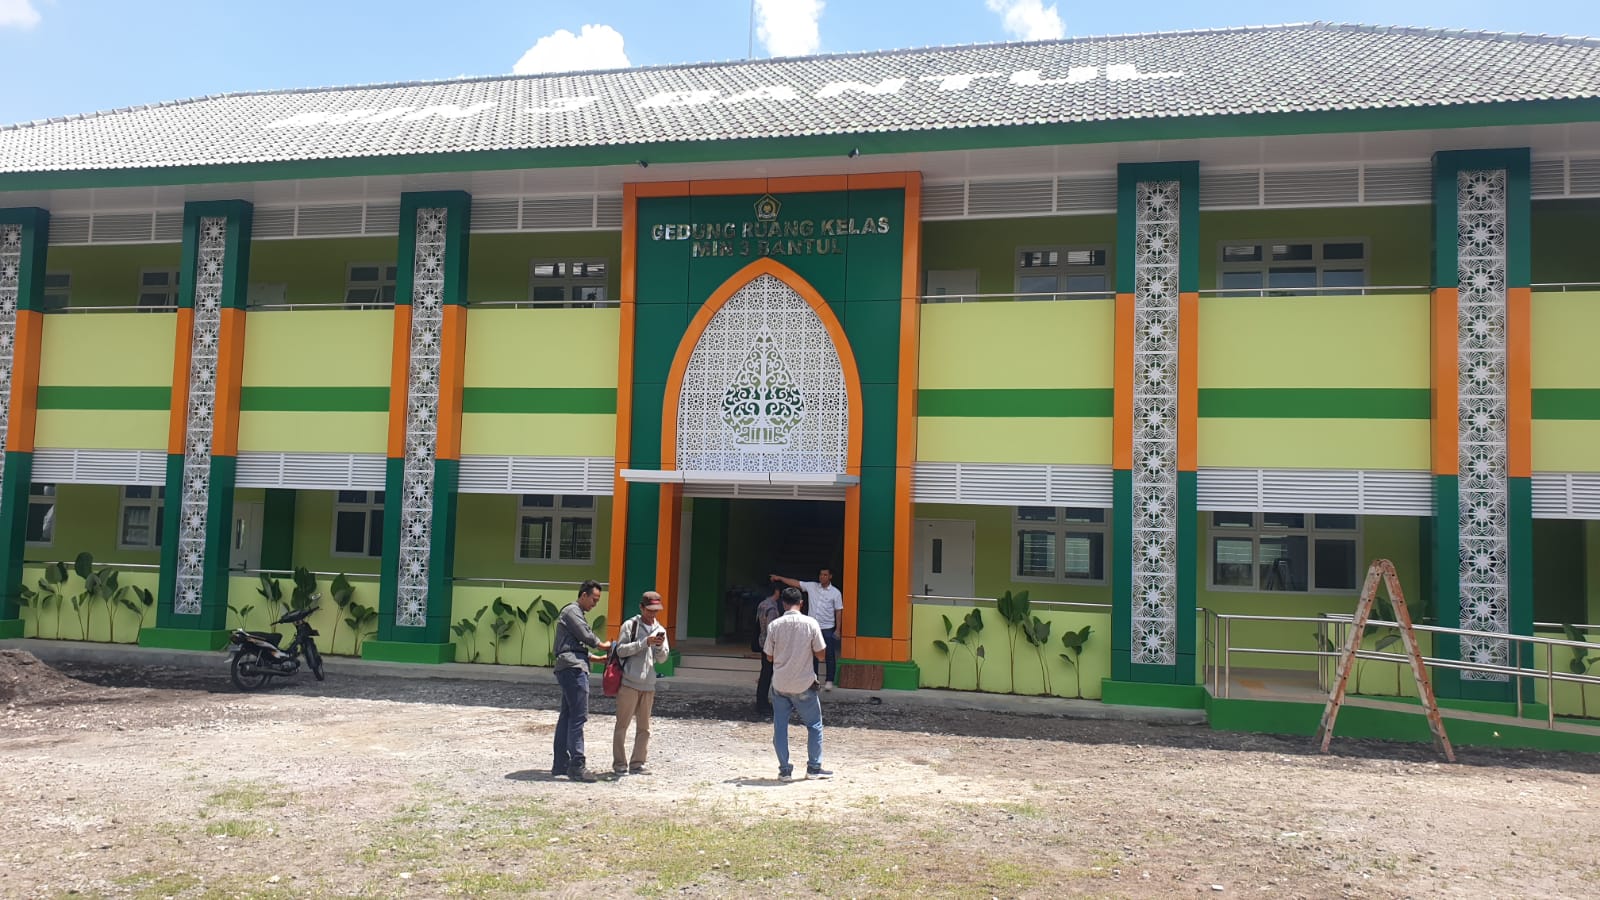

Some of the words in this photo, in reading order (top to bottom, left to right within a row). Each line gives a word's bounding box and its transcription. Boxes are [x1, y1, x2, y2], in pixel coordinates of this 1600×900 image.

[652, 222, 736, 241] GEDUNG
[742, 220, 814, 238] RUANG
[821, 216, 890, 236] KELAS
[692, 240, 734, 257] MIN
[740, 239, 751, 256] 3
[758, 237, 843, 256] BANTUL
